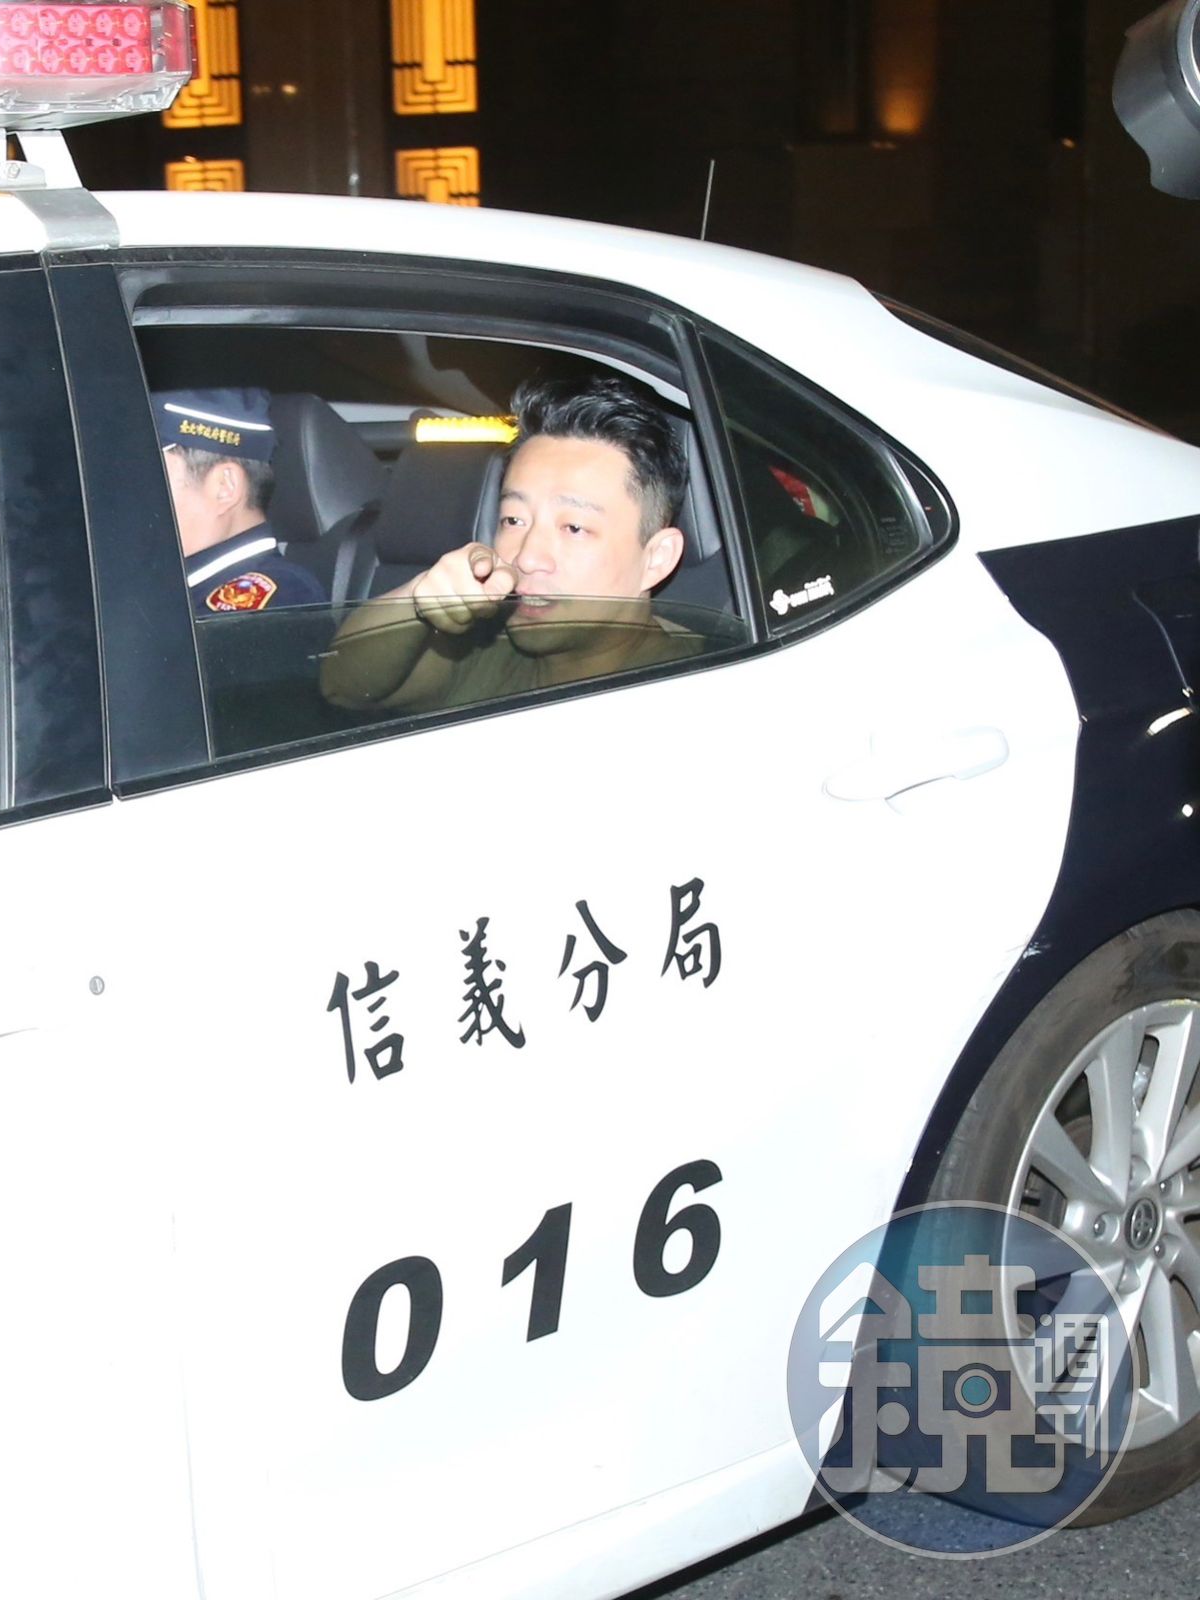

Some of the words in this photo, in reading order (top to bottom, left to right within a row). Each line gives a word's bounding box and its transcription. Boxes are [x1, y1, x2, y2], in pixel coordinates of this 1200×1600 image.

[326, 877, 722, 1084] 信義分局
[341, 1158, 723, 1402] 016
